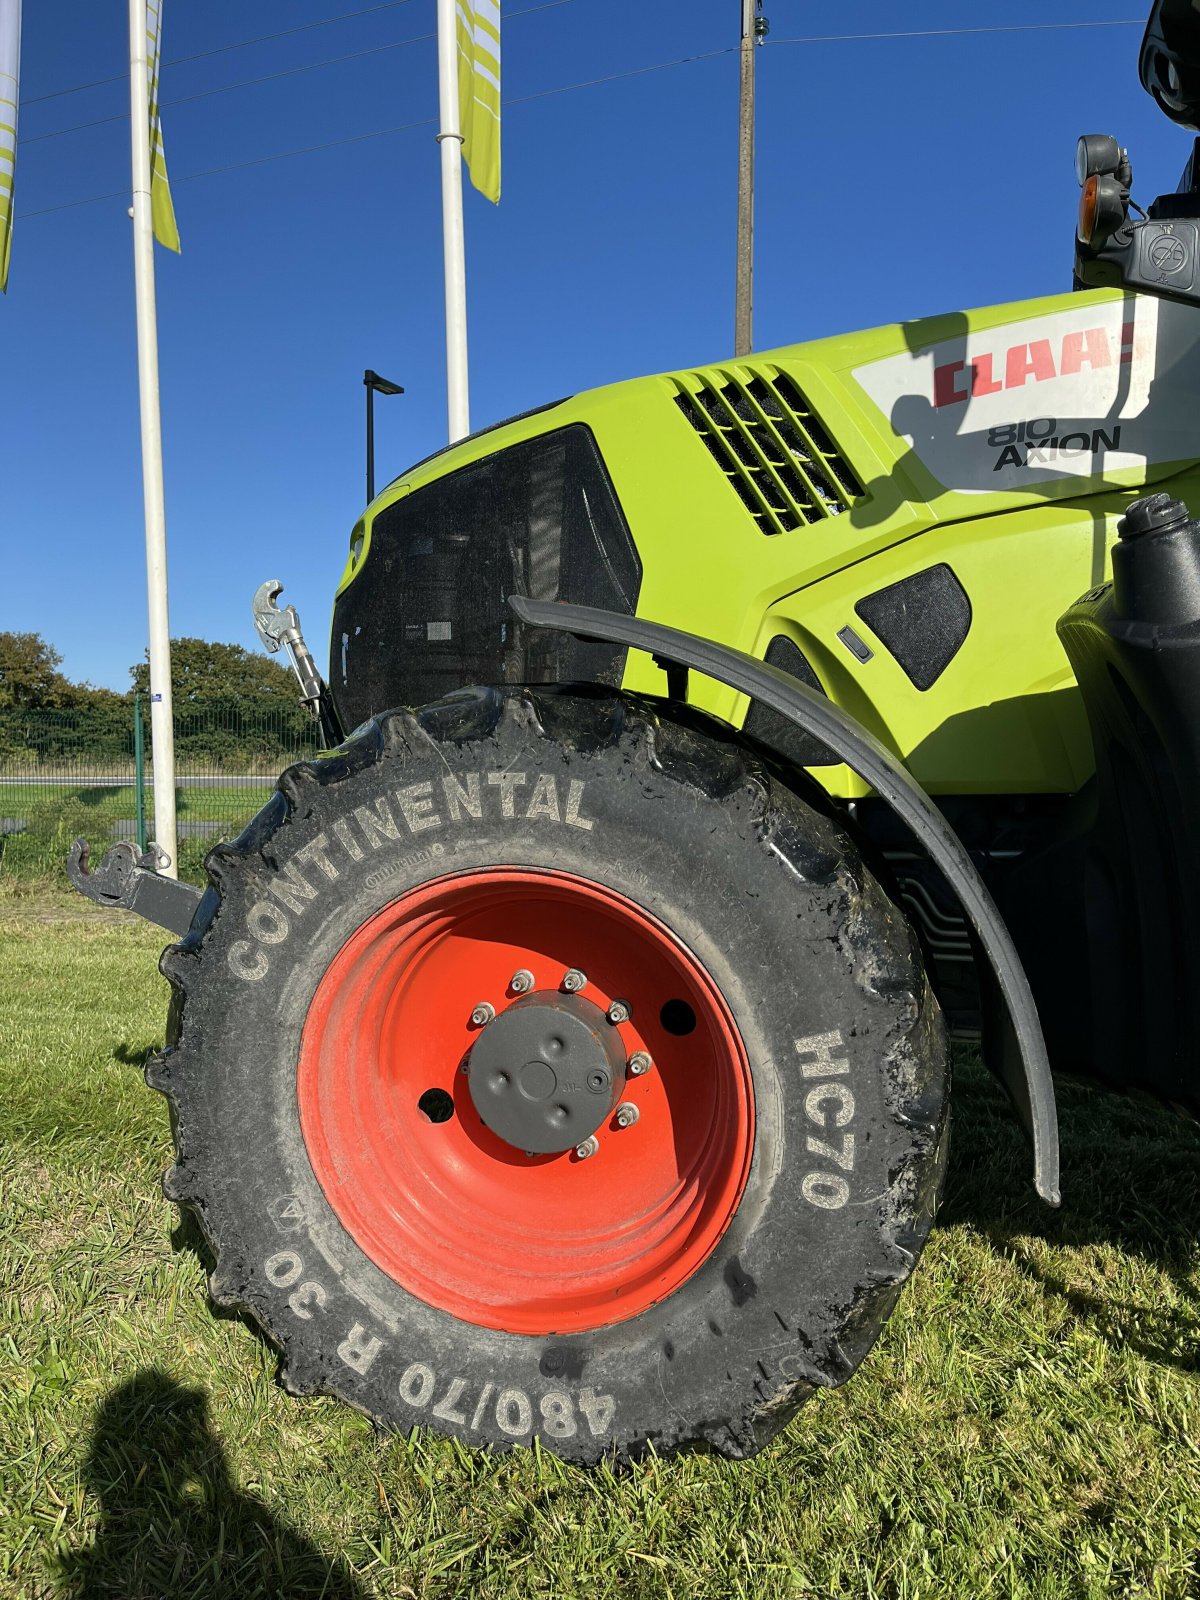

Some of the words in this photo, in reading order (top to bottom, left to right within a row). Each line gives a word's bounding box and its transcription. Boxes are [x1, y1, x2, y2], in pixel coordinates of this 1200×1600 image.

[987, 415, 1057, 447] 810
[992, 425, 1121, 471] AXION
[226, 772, 594, 981] CONTINENTAL
[794, 1029, 855, 1210] HC70
[264, 1250, 328, 1320] 30
[336, 1321, 383, 1376] R
[399, 1362, 616, 1438] 480/70
